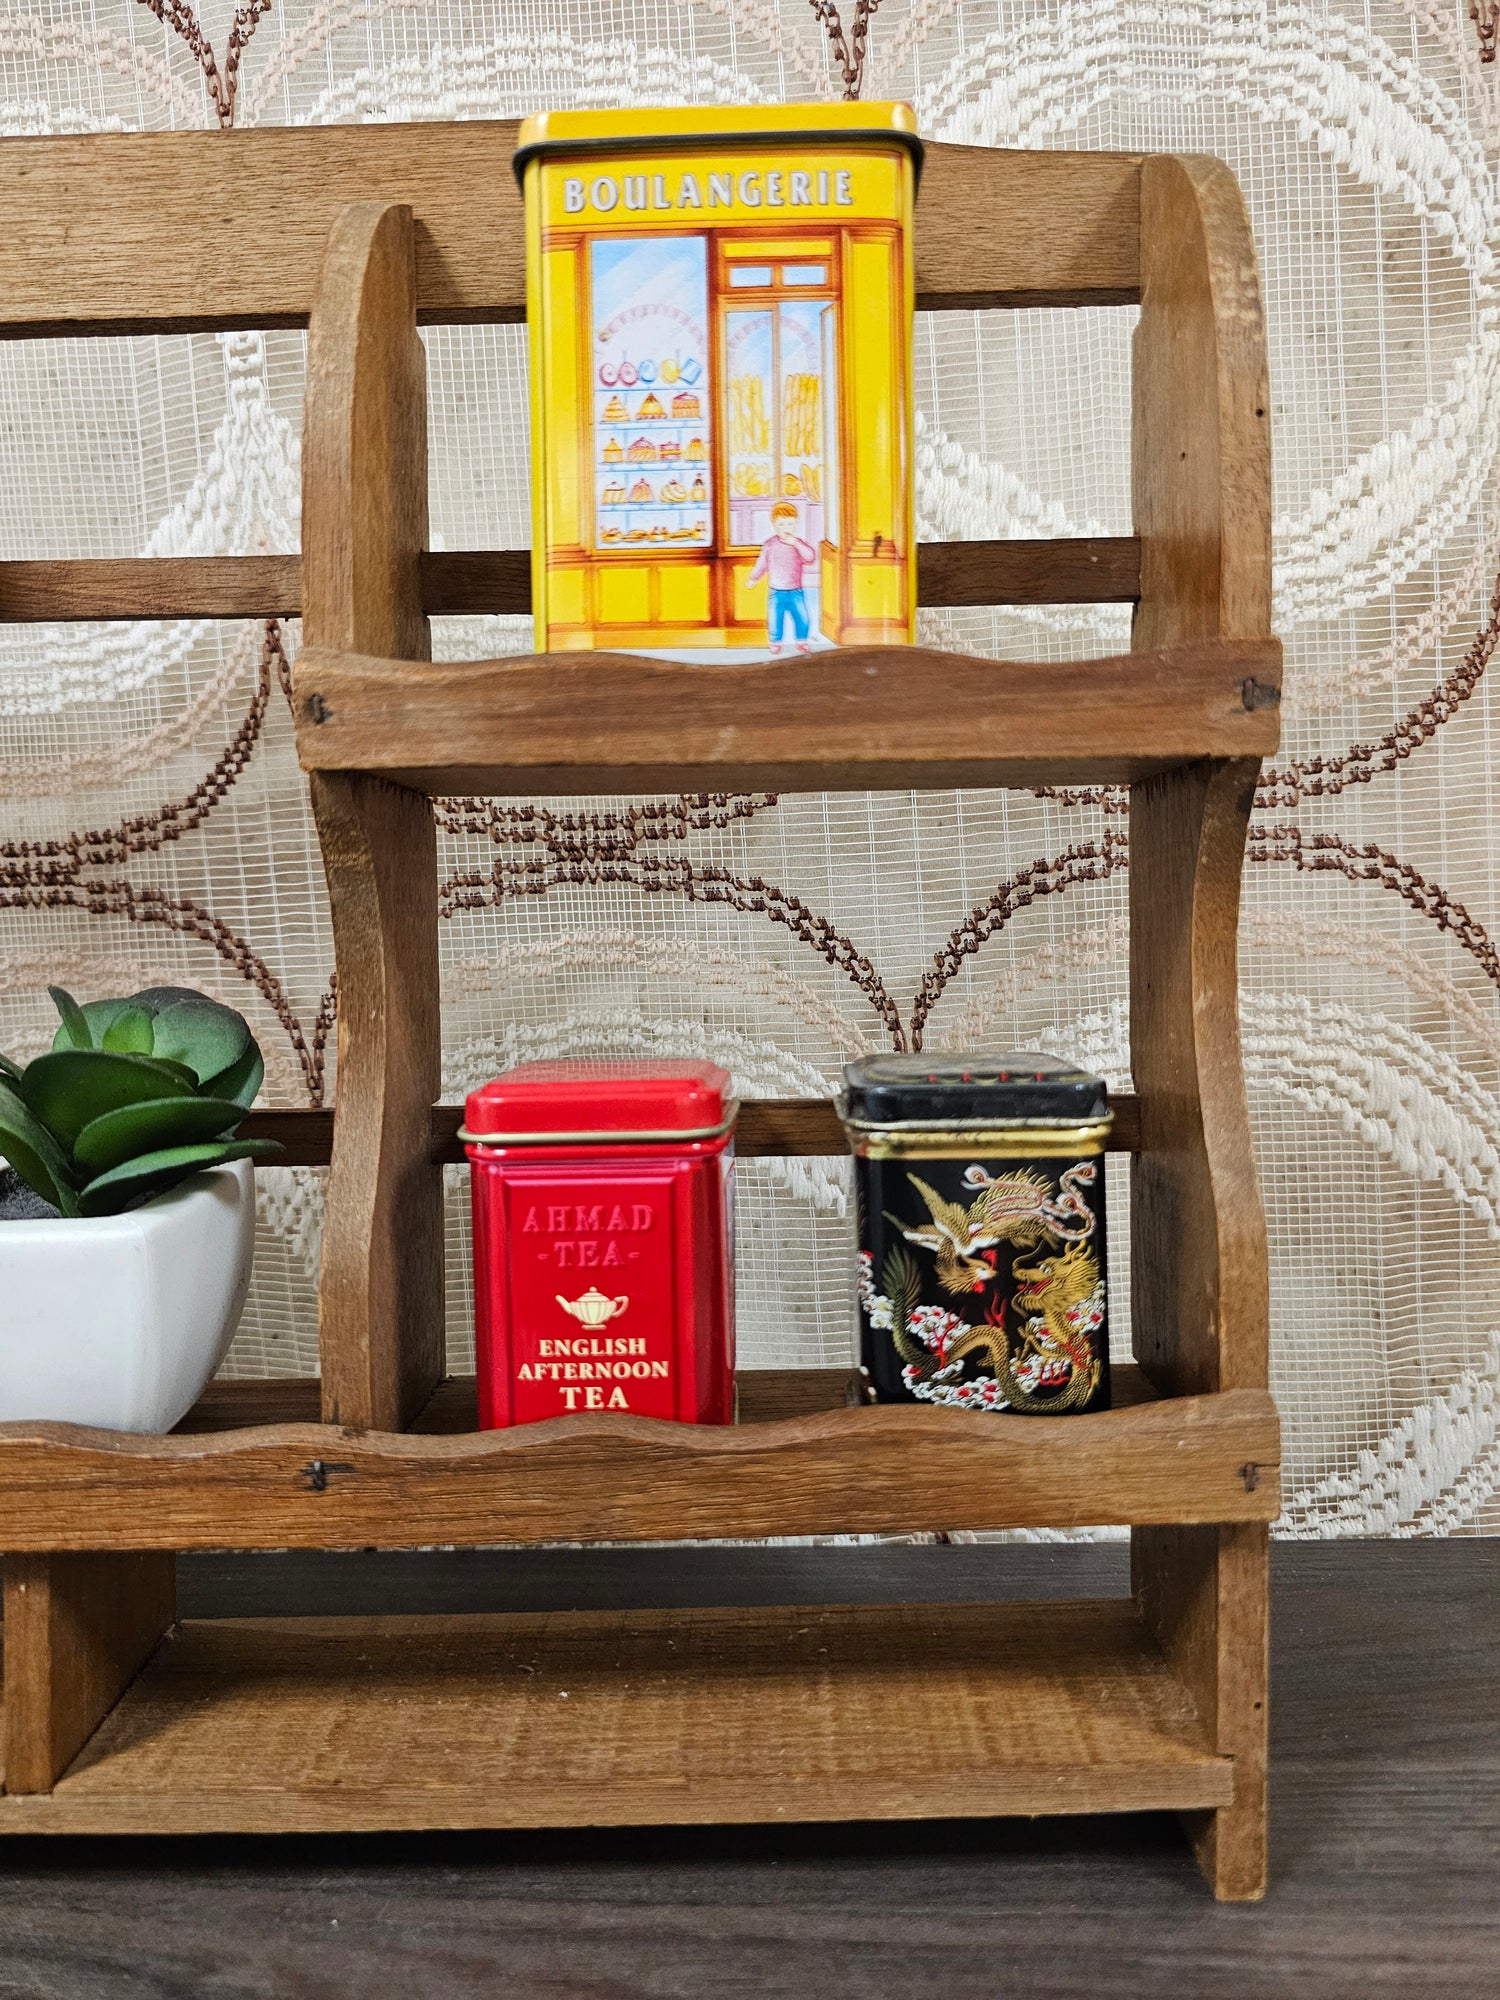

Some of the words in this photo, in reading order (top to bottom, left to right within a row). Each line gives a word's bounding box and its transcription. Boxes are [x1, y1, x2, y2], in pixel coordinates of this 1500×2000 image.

[563, 170, 854, 214] BOULANGERIE
[522, 1205, 654, 1232] AHMAD
[538, 1337, 647, 1357] ENGLISH
[517, 1361, 669, 1380] AFTERNOON
[559, 1386, 630, 1409] TEA
